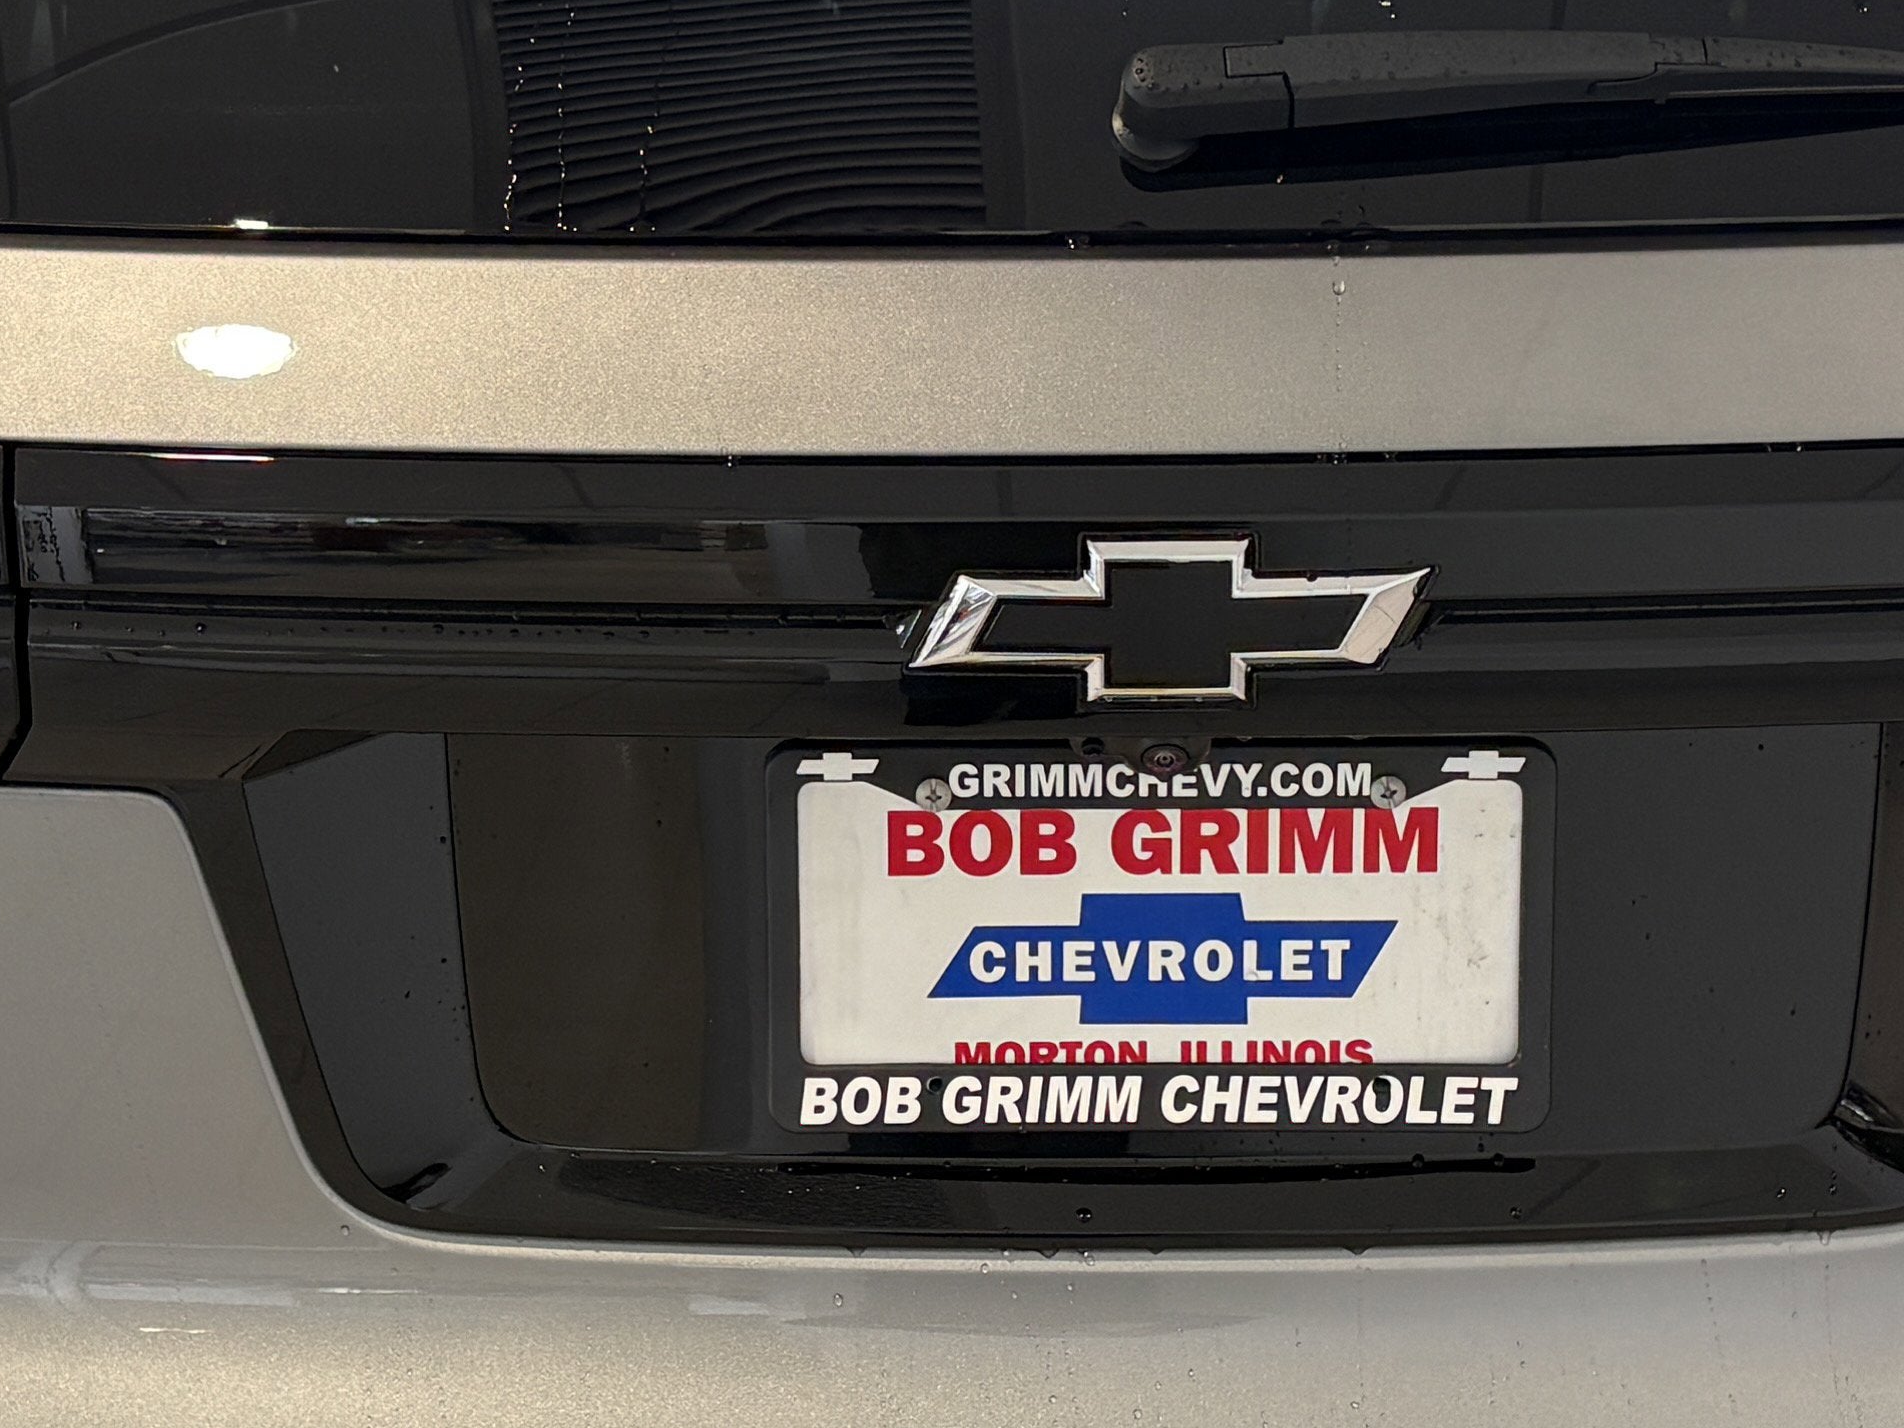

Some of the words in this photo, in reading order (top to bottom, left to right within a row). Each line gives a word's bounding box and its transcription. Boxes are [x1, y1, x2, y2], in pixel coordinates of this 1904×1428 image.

[948, 763, 1372, 798] GRIMMCHEVY.COM
[887, 810, 1078, 877] BOB
[1111, 808, 1439, 875] GRIMM
[969, 940, 1351, 983] CHEVROLET
[954, 1040, 1148, 1064] MORTON
[799, 1076, 922, 1126] BOB
[942, 1075, 1142, 1125] GRIMM
[1160, 1074, 1519, 1124] CHEVROLET
